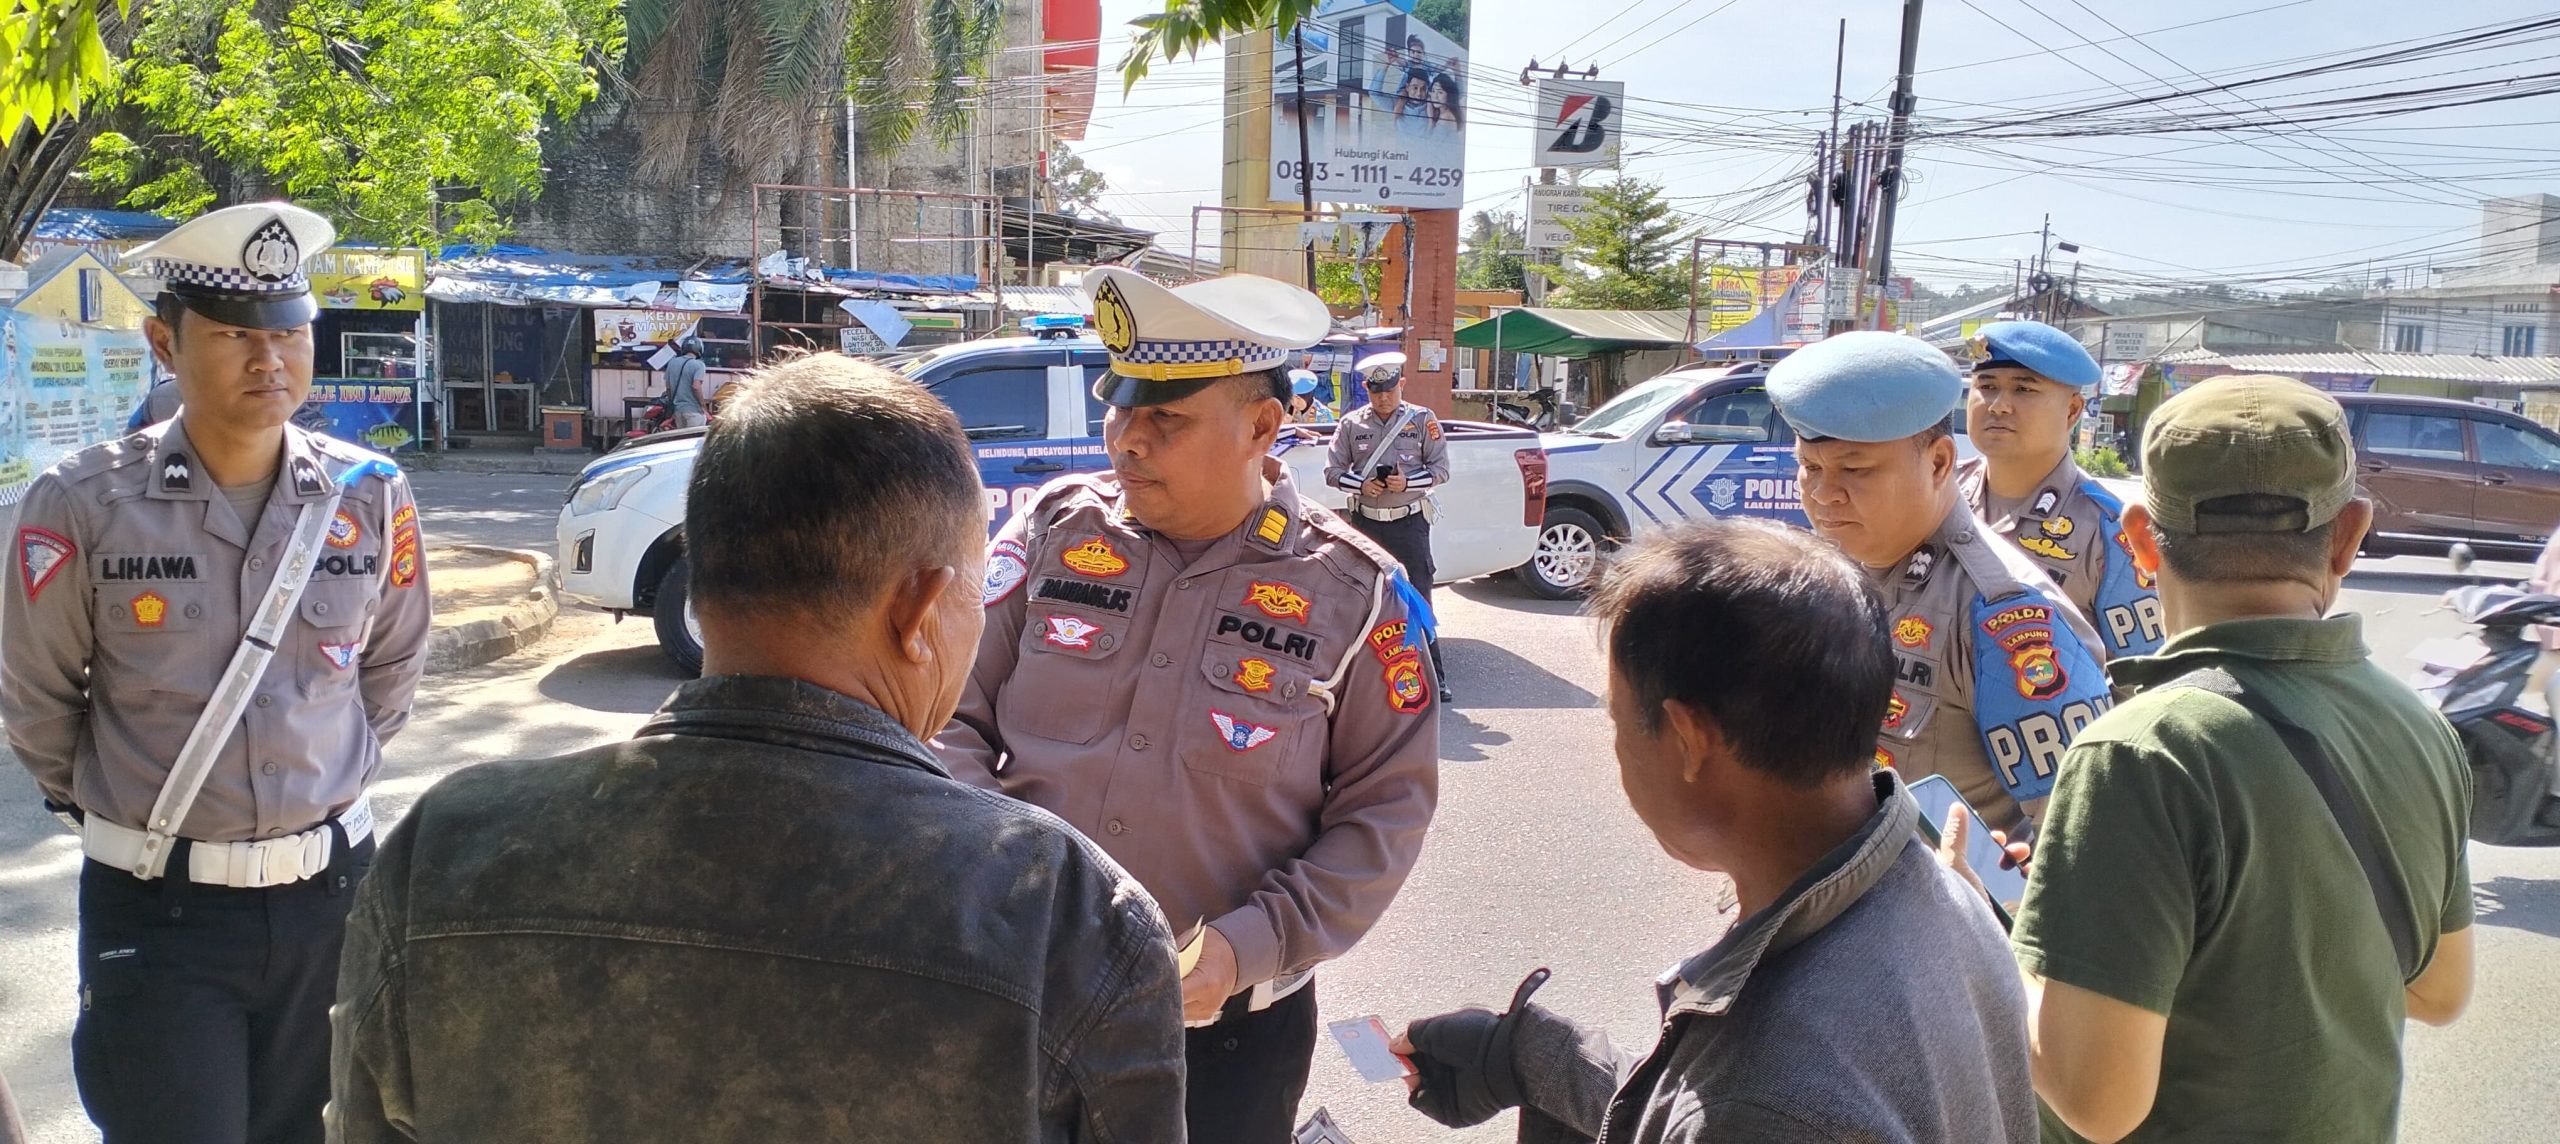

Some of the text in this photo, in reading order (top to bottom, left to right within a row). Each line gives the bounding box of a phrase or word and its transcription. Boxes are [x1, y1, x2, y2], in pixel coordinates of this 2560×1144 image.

[1335, 148, 1409, 161] Hubungi Kami
[1277, 160, 1329, 181] 0813
[1351, 165, 1388, 184] 1111
[1409, 167, 1463, 187] 4259
[1547, 204, 1570, 212] TIRE
[645, 311, 691, 321] KEDAI
[1027, 446, 1070, 457] MENGAYOMI
[1072, 446, 1087, 454] DAN
[102, 556, 197, 580] LIHAWA
[1217, 615, 1317, 661] POLRI
[1373, 622, 1408, 645] POLD
[2006, 630, 2049, 647] LAMPUNG
